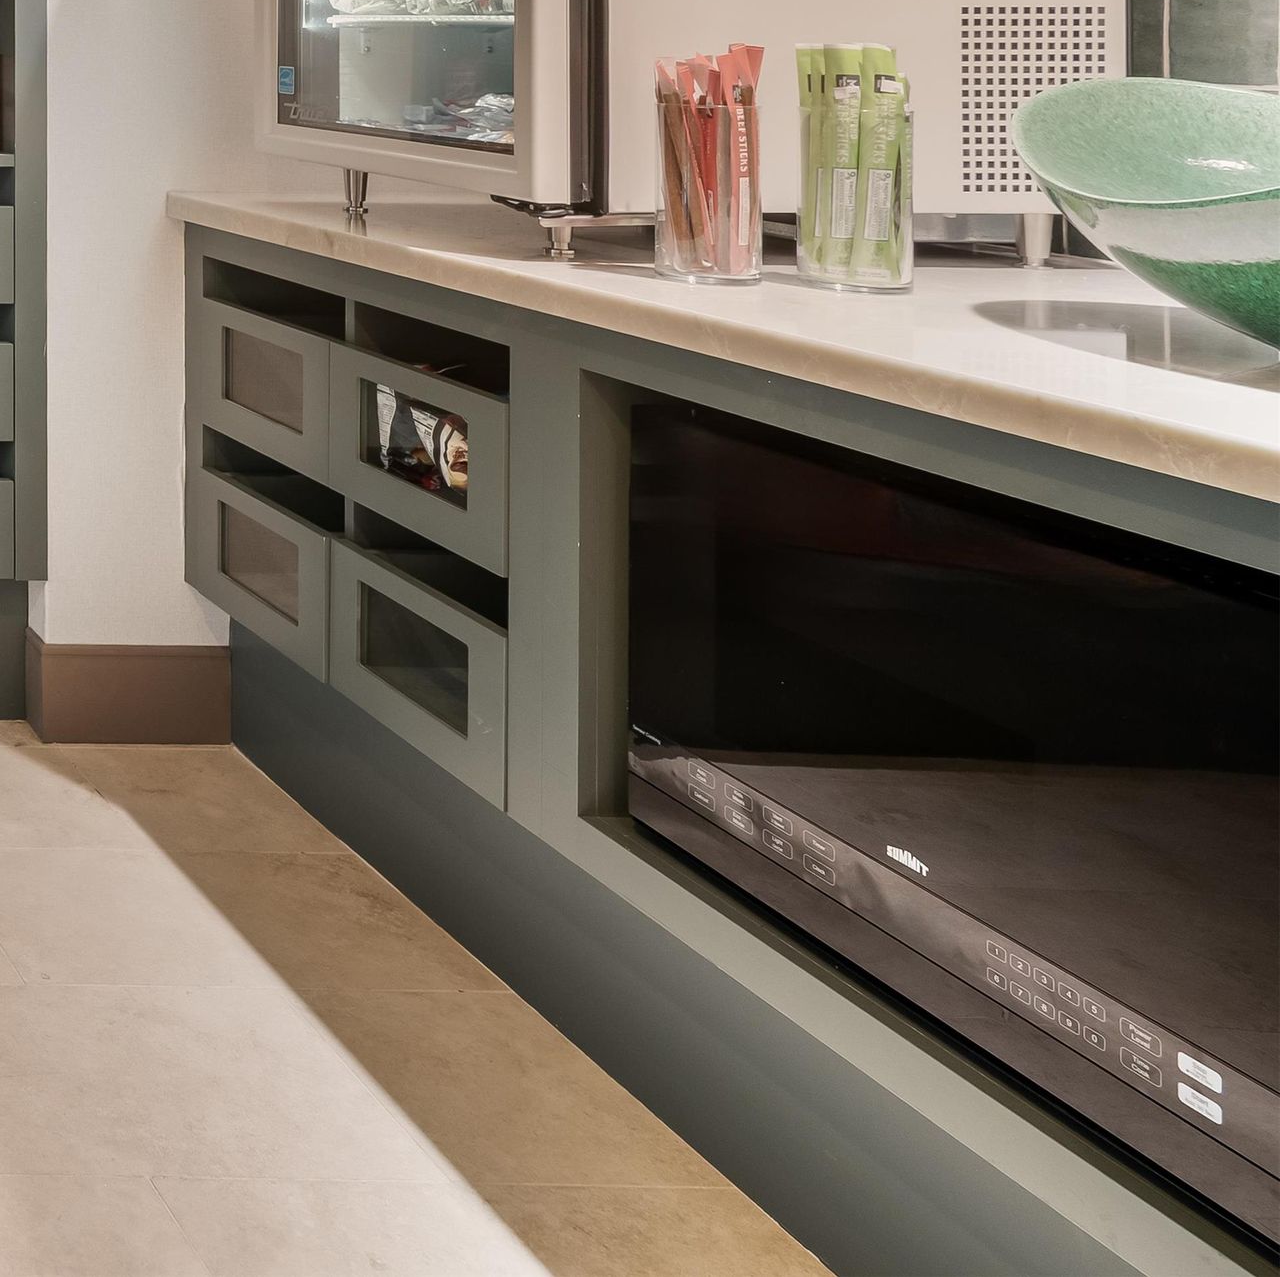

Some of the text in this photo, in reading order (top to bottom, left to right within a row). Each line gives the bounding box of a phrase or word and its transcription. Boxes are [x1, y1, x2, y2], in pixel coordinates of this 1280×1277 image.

[738, 135, 749, 173] STICKS
[886, 844, 930, 877] SUMMIT
[993, 946, 1000, 956] 1
[1017, 961, 1023, 970] 2
[993, 974, 1000, 984] 6
[1041, 974, 1047, 984] 3
[1017, 988, 1023, 998] 7
[1066, 990, 1072, 999] 4
[1041, 1002, 1047, 1012] 8
[1091, 1005, 1098, 1014] 5
[1066, 1018, 1072, 1028] 9
[1129, 1023, 1152, 1041] Power
[1091, 1033, 1098, 1043] 0
[1130, 1031, 1152, 1050] Level
[1132, 1054, 1150, 1071] Time
